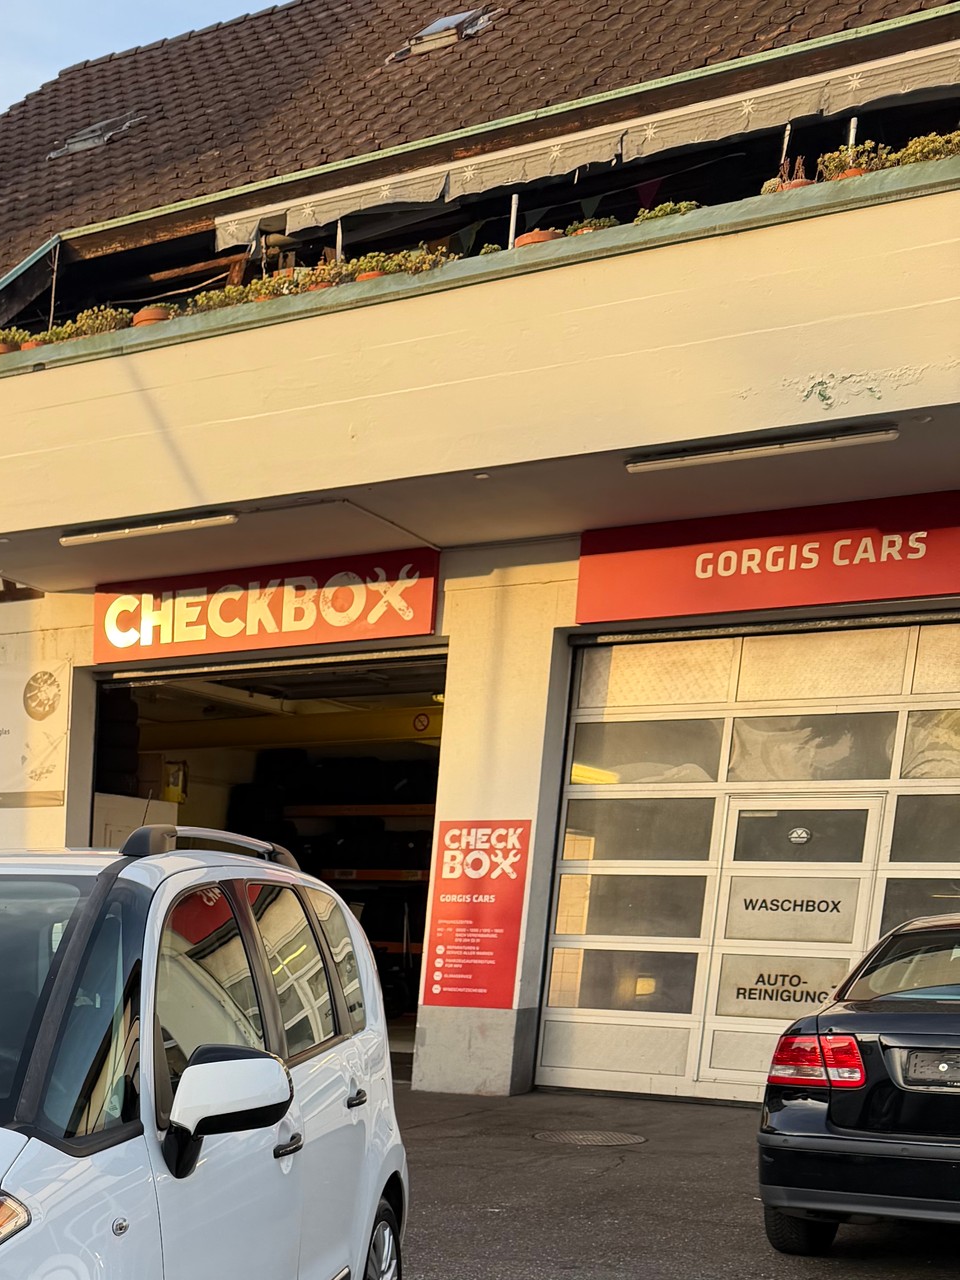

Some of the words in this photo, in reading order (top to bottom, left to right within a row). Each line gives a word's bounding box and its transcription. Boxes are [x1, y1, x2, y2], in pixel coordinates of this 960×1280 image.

[695, 542, 820, 579] GORGIS
[832, 531, 928, 566] CARS
[104, 564, 420, 649] CHECKBOX
[444, 827, 524, 850] CHECK
[442, 849, 521, 880] BOX
[440, 894, 471, 903] GORGIS
[472, 894, 496, 903] CARS
[743, 898, 842, 913] WASCHBOX
[755, 973, 808, 987] AUTO-
[736, 987, 830, 1004] REINIGUNG
